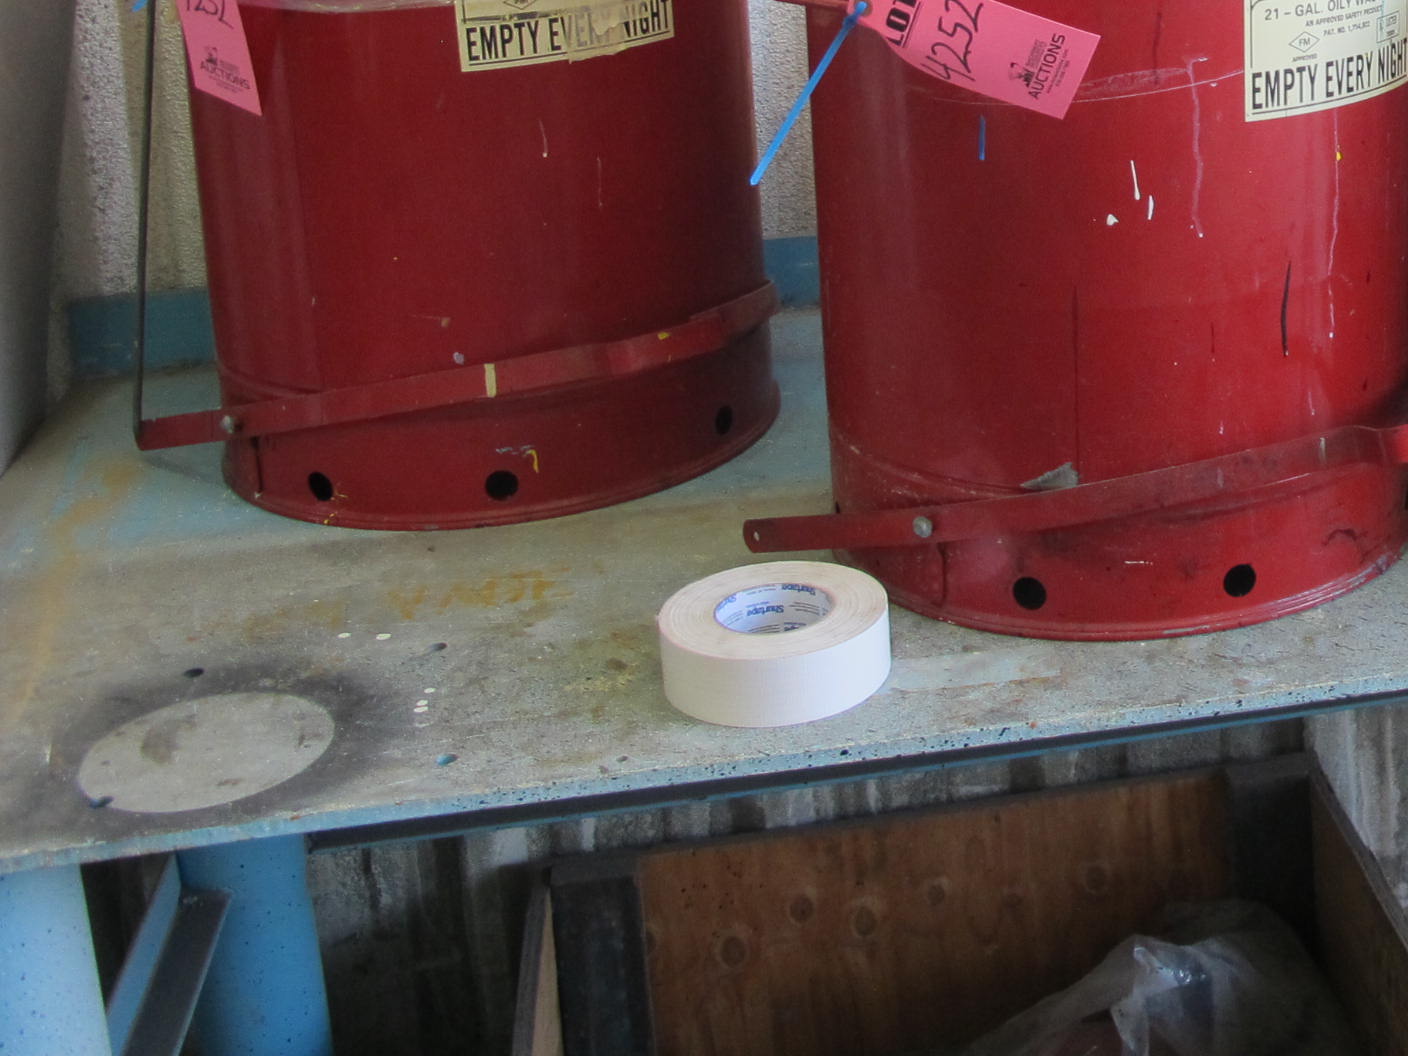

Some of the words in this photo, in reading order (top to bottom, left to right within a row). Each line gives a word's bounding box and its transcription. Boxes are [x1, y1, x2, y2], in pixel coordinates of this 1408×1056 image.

[1264, 8, 1279, 21] 21
[1295, 2, 1324, 17] GAL.
[465, 20, 540, 62] EMPTY
[1298, 37, 1311, 47] FM
[1028, 33, 1065, 100] AUCTIONS
[1252, 63, 1318, 110] EMPTY
[1325, 50, 1373, 98] EVERY
[1378, 37, 1408, 84] NIGHT
